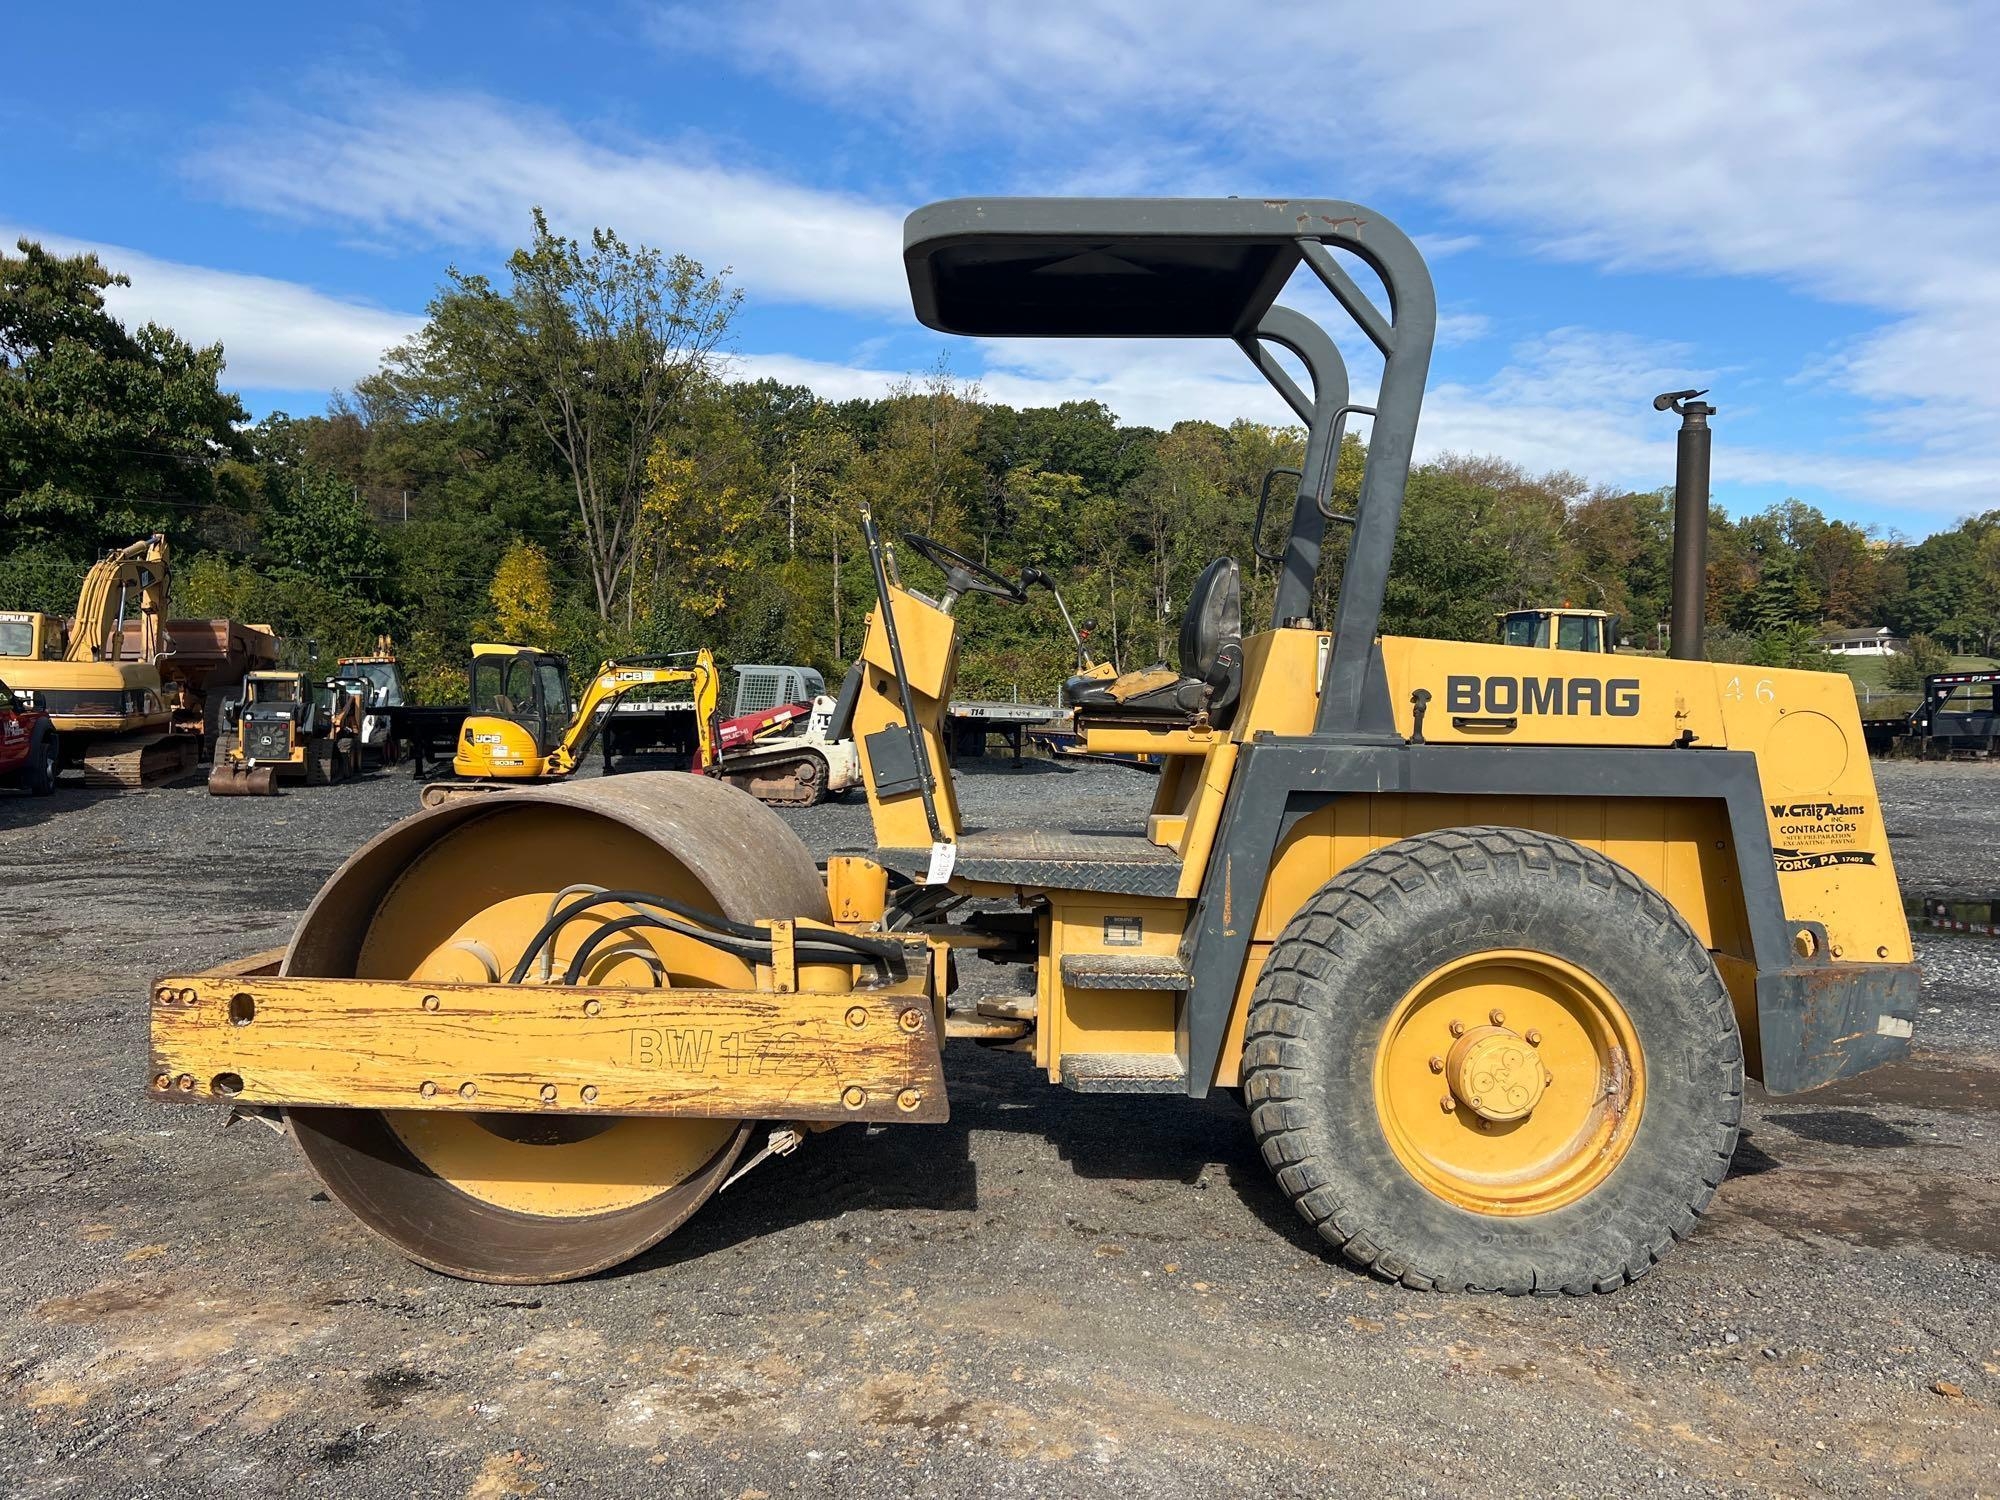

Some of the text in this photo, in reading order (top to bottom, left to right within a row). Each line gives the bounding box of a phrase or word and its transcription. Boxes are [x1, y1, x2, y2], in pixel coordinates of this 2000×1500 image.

[616, 672, 642, 681] JCB
[1447, 676, 1640, 717] BOMAG
[476, 735, 501, 743] JCB
[1815, 803, 1864, 816] Adams
[1780, 823, 1857, 834] CONTRACTORS
[1820, 854, 1838, 866] PA
[1402, 912, 1540, 968] TITAN
